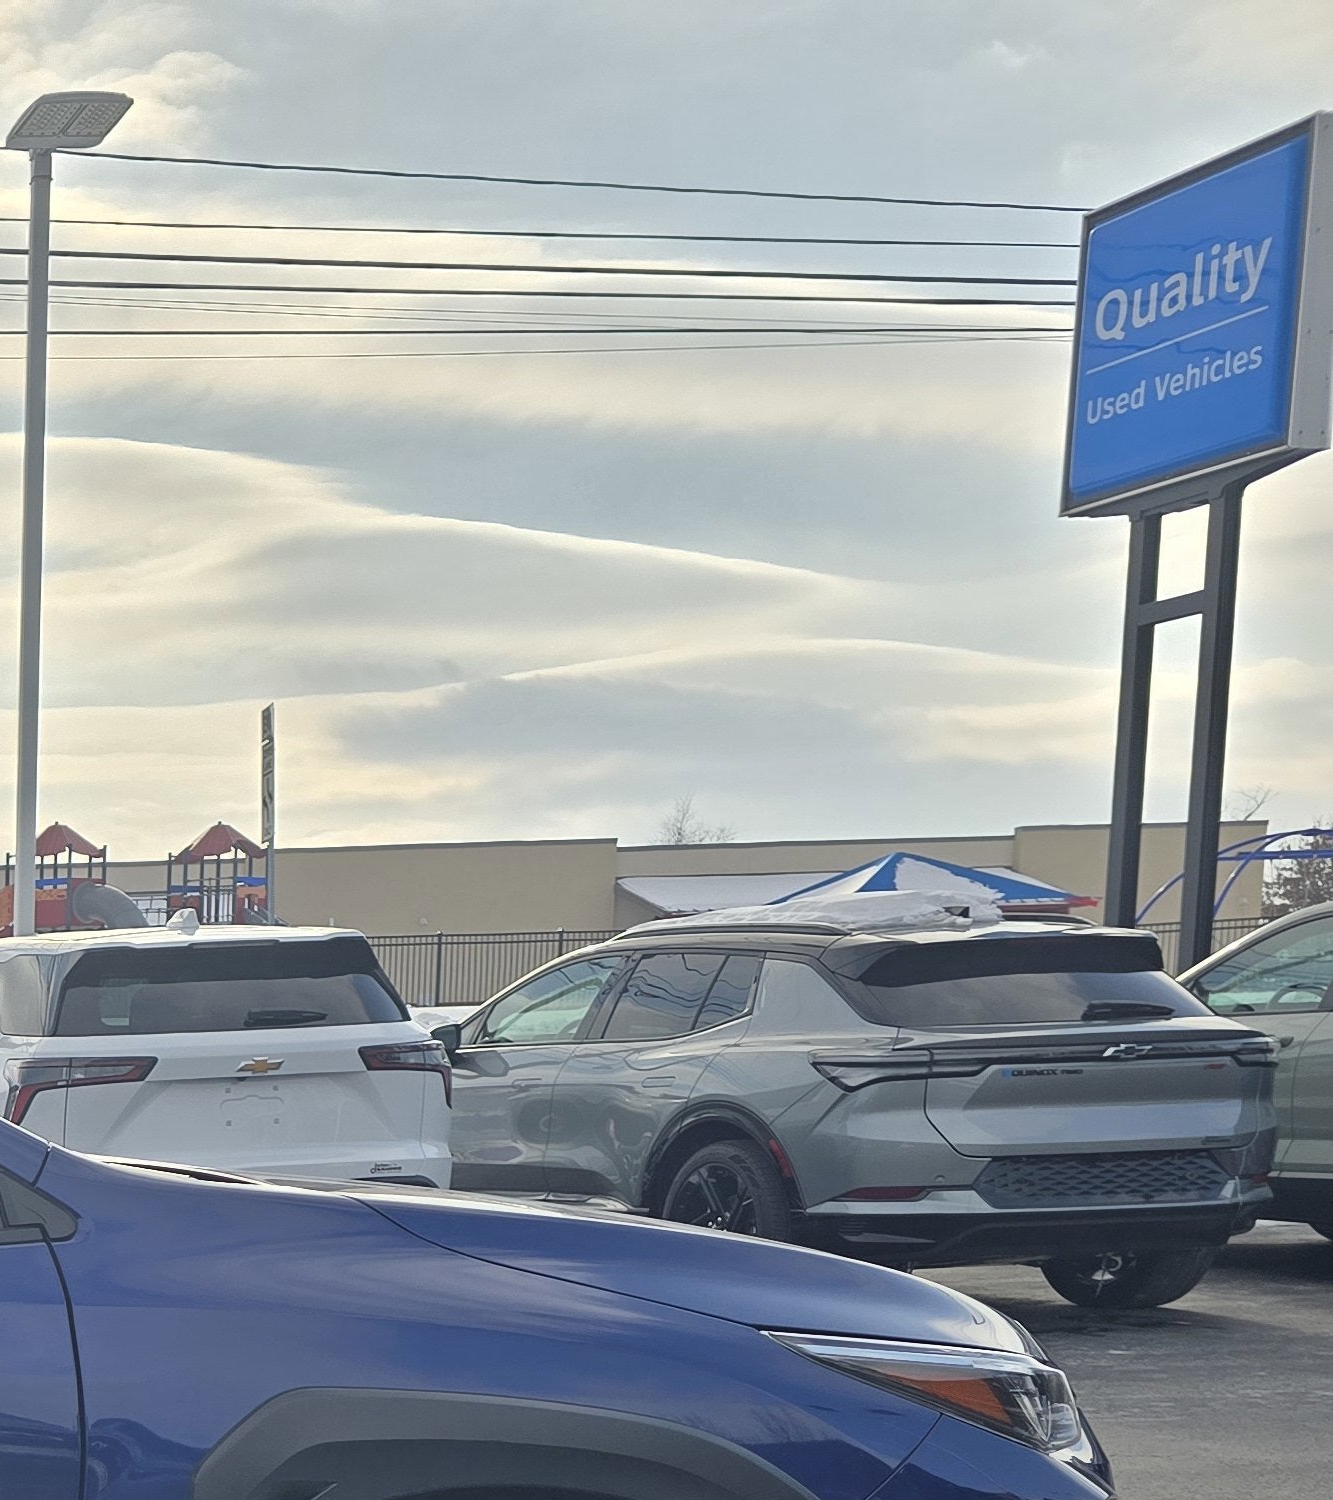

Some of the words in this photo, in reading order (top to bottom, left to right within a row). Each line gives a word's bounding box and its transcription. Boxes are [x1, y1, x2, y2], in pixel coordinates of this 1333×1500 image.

[1095, 237, 1272, 341] Quality
[1086, 381, 1145, 425] Used
[1154, 345, 1263, 401] Vehicles
